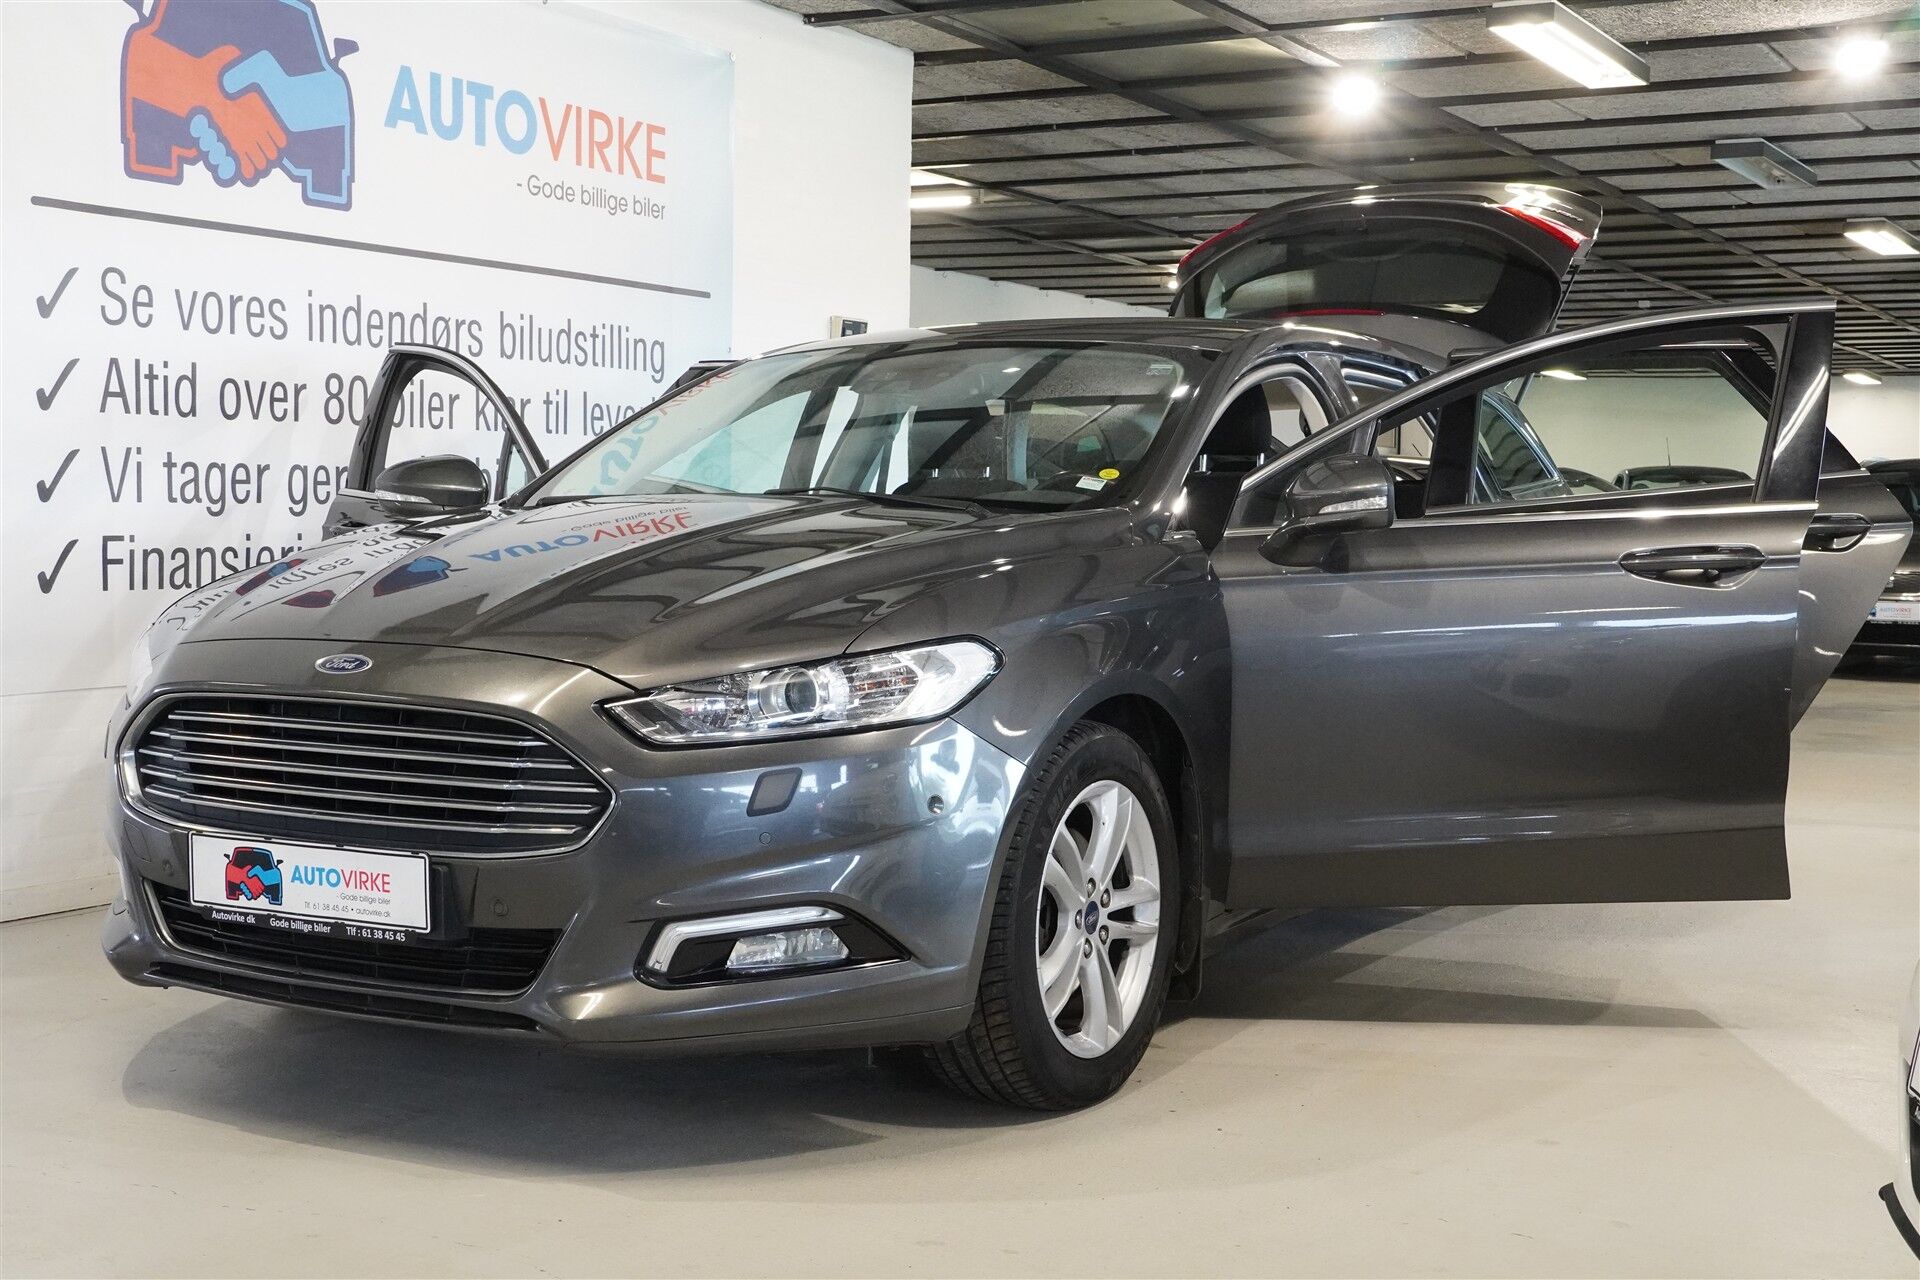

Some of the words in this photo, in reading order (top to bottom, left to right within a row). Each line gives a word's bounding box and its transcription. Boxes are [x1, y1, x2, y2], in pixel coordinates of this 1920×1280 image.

[384, 64, 666, 184] AUTOVIRKE
[527, 174, 576, 202] Gode
[580, 181, 628, 216] billige
[633, 194, 666, 220] biler
[100, 266, 154, 328] Se
[174, 288, 288, 340] vores
[307, 289, 484, 358] indendørs
[499, 310, 665, 384] biludstilling
[99, 356, 197, 418] Altid
[219, 377, 307, 422] over
[323, 372, 369, 426] 80
[543, 388, 568, 434] til
[101, 446, 142, 503] Vi
[162, 451, 270, 517] tager
[288, 463, 348, 517] ger
[290, 864, 391, 893] AUTOVIRKE
[312, 902, 320, 910] 61
[322, 903, 330, 911] 38
[331, 904, 340, 912] 45
[341, 905, 349, 913] 45
[340, 892, 358, 901] Gode
[359, 894, 377, 905] billige
[378, 896, 391, 905] biler
[211, 910, 245, 923] Autovirke
[246, 914, 256, 924] dk
[269, 918, 289, 929] Gode
[290, 920, 313, 933] billige
[314, 922, 332, 933] biler
[362, 928, 372, 938] 61
[373, 929, 383, 939] 38
[384, 931, 394, 940] 45
[395, 932, 406, 942] 45
